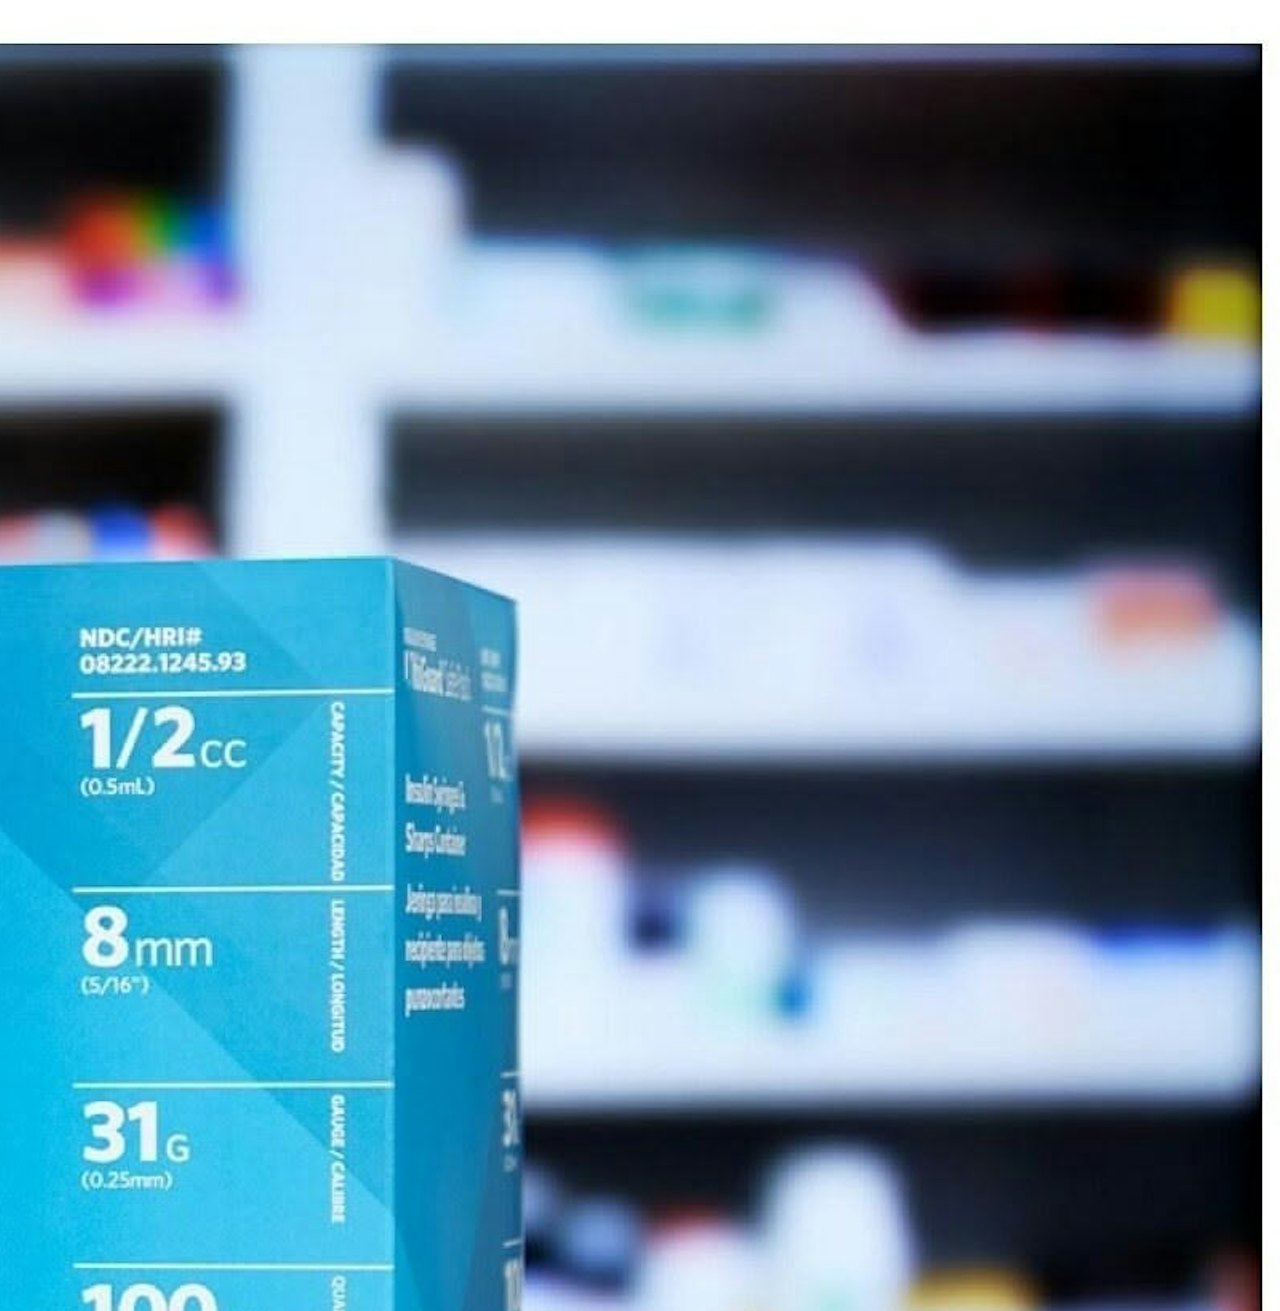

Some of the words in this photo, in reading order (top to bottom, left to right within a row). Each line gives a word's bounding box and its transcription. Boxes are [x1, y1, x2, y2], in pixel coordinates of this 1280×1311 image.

[79, 651, 247, 675] 08222.1245.93
[80, 626, 202, 649] NDC/HRI#
[330, 700, 346, 778] CAPACITY
[80, 776, 156, 797] (0.5mL)
[330, 791, 346, 882] CAPACIDAD
[330, 899, 346, 960] LENGTH
[329, 973, 346, 1053] LONGITUD
[330, 1094, 346, 1148] GAUGE
[81, 1170, 173, 1191] (0.25mm)
